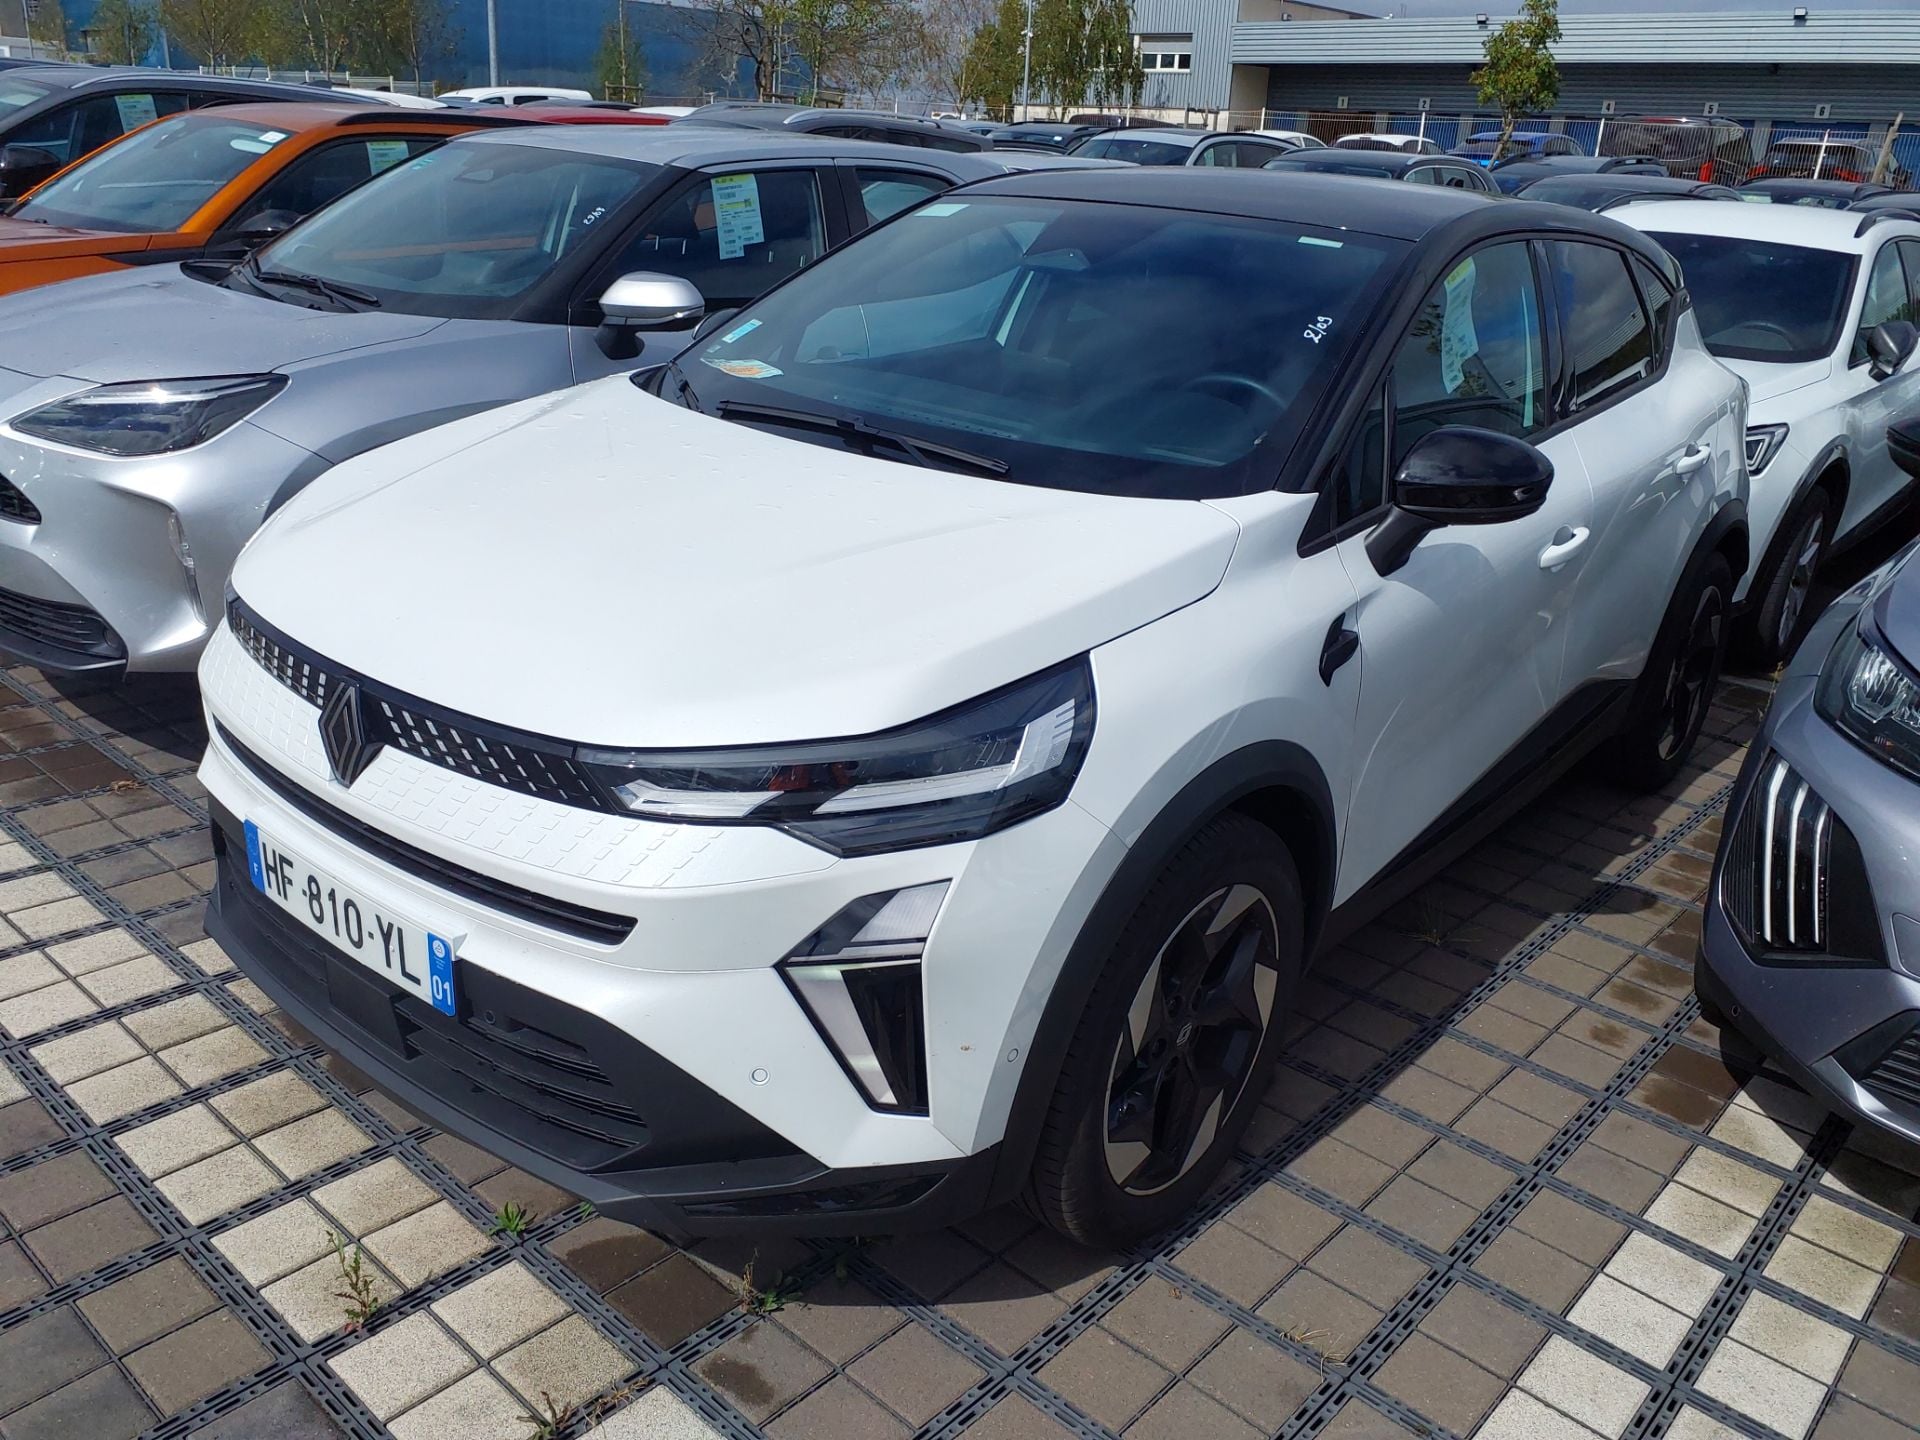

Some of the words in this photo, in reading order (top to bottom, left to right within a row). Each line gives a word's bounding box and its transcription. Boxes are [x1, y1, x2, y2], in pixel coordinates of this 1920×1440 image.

[1707, 104, 1714, 114] 5
[1819, 106, 1826, 117] 6
[432, 975, 452, 1006] 01
